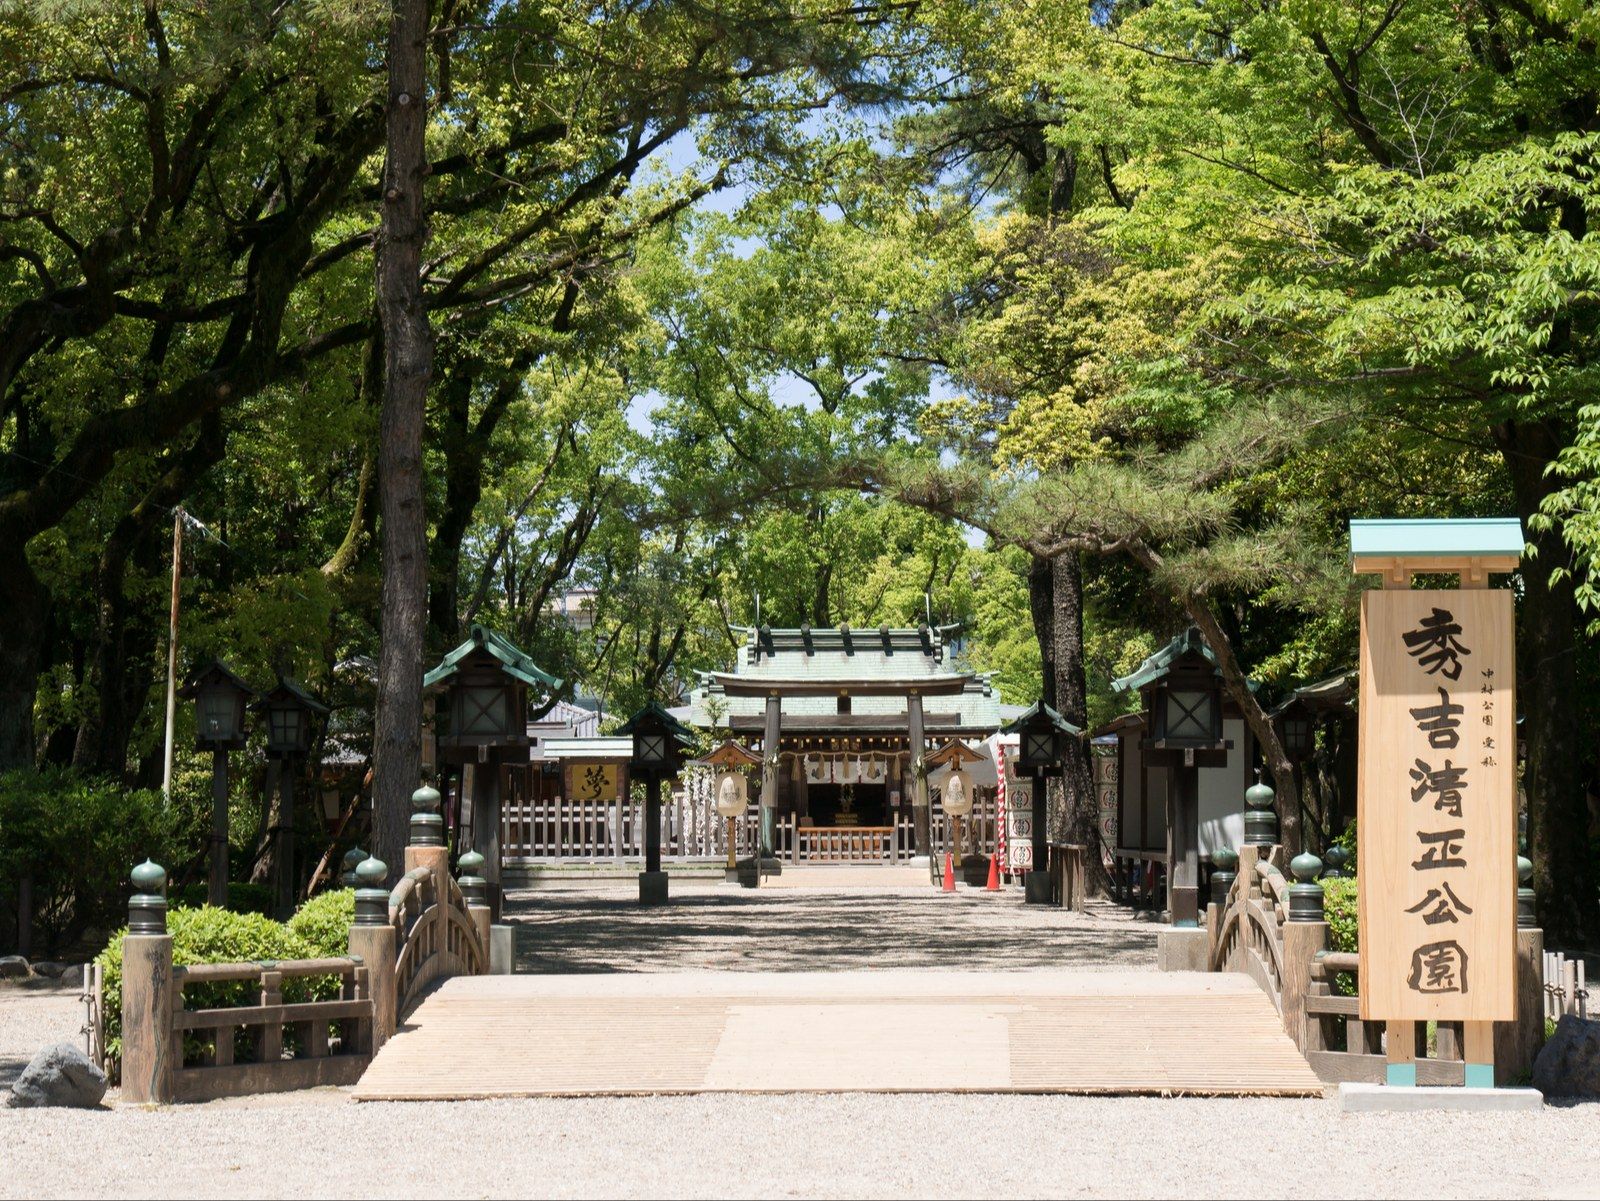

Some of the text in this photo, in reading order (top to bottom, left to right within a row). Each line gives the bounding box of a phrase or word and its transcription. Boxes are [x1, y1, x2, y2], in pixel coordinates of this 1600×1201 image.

[1480, 667, 1495, 727] 中村公園
[581, 764, 610, 799] 夢
[1401, 607, 1473, 994] 秀吉清正公園
